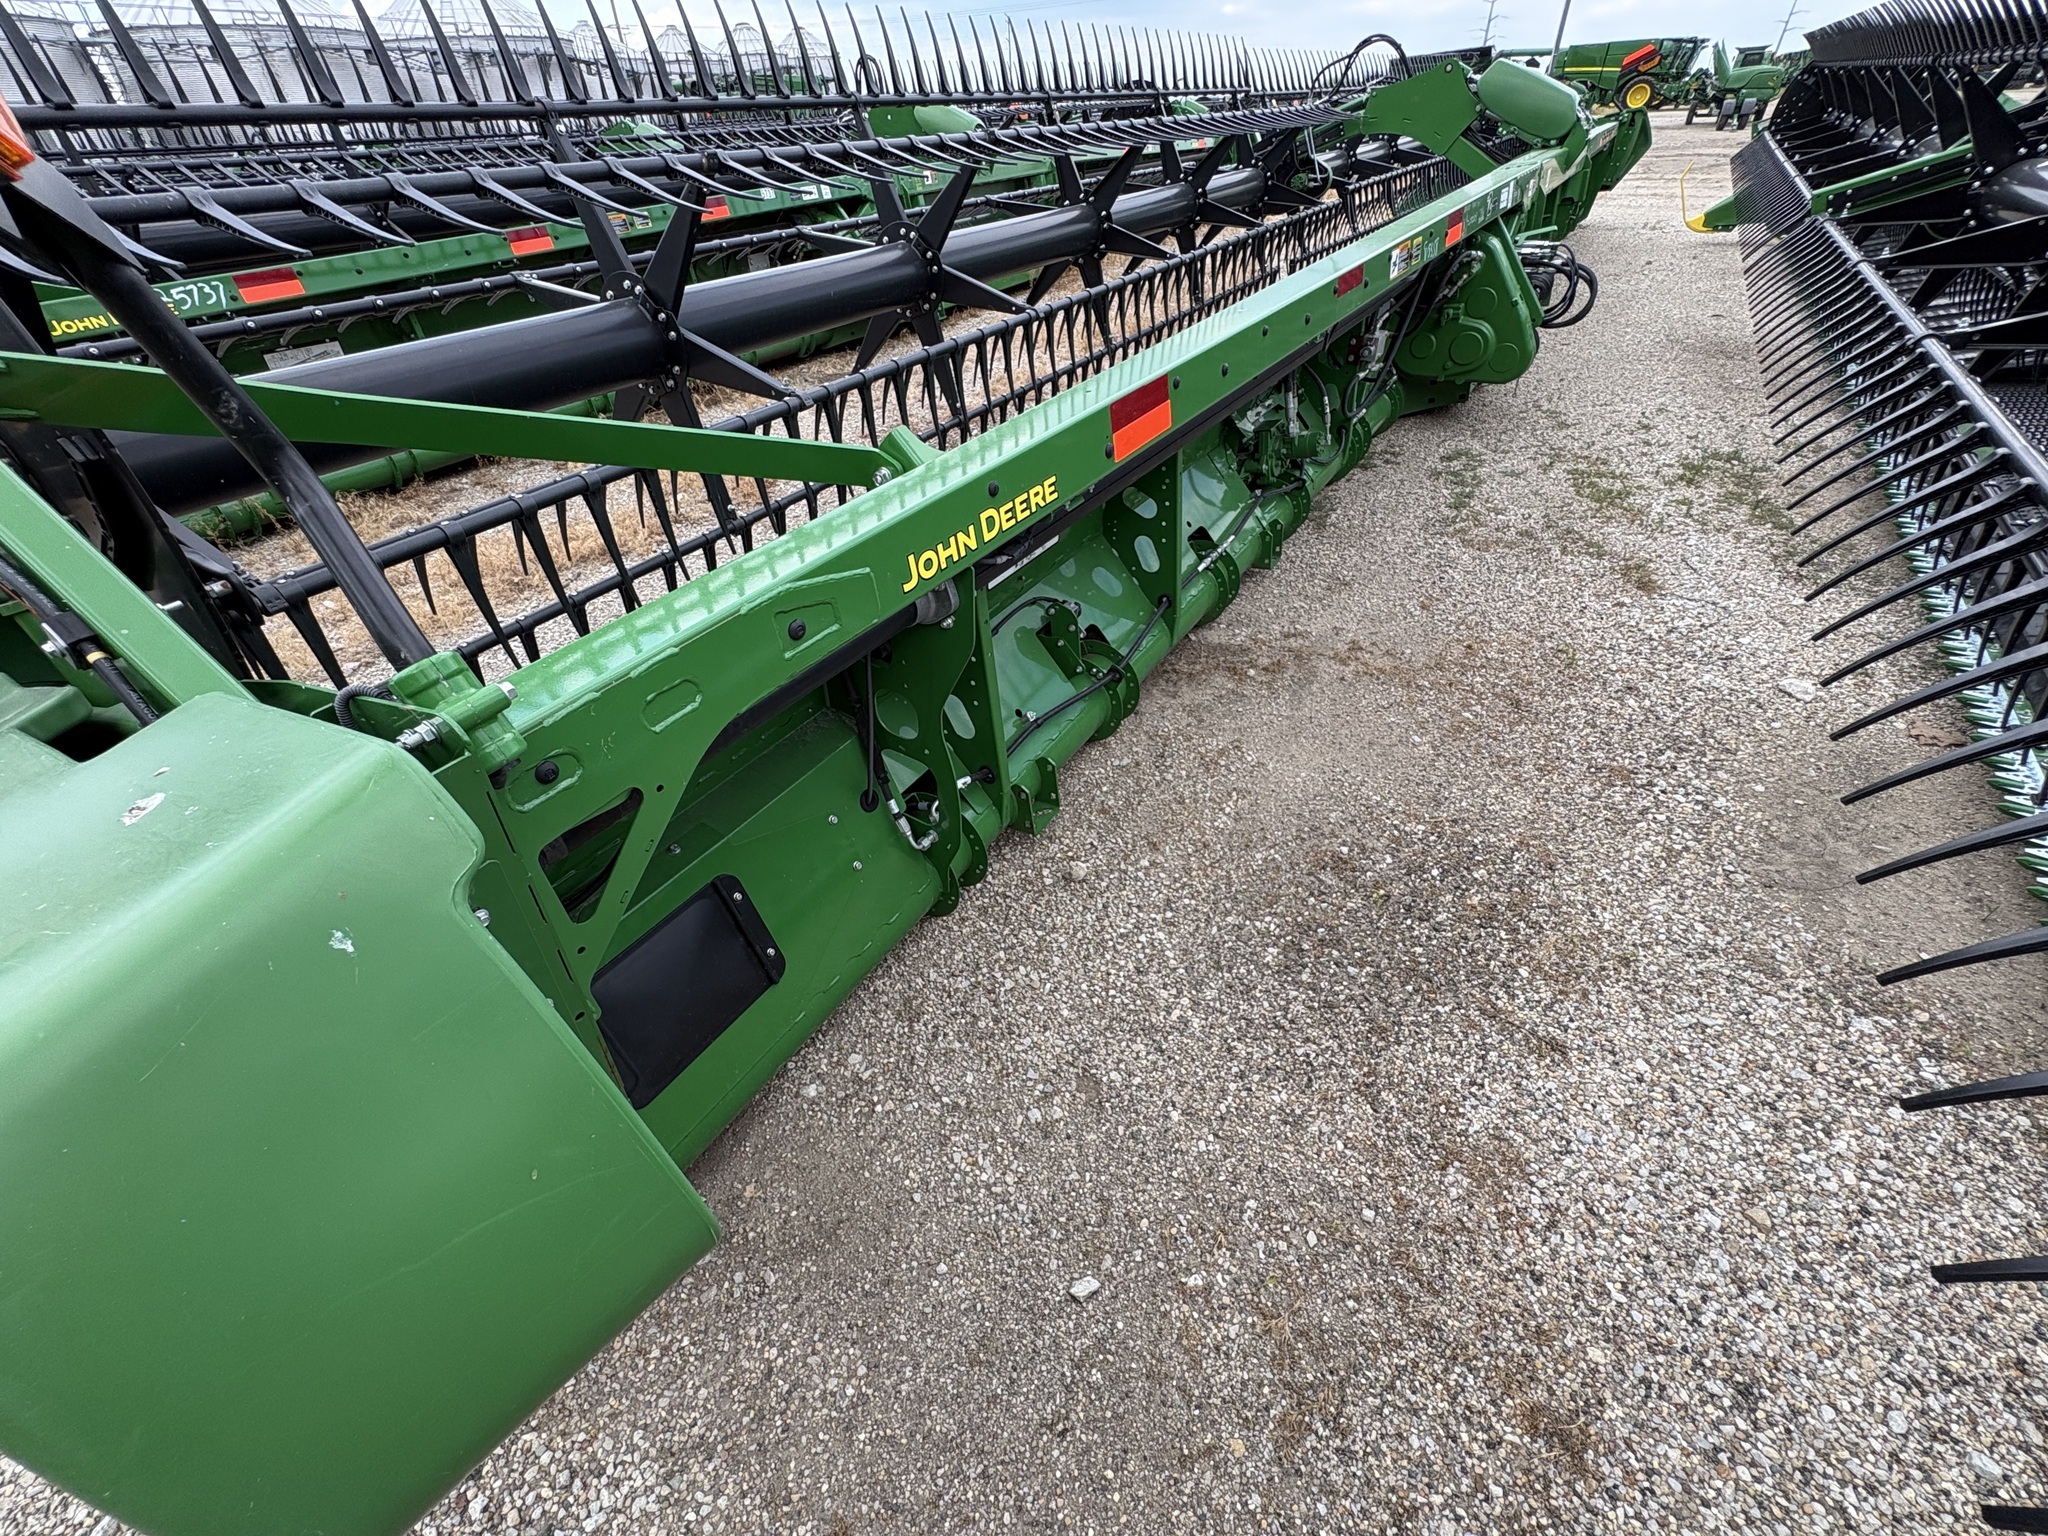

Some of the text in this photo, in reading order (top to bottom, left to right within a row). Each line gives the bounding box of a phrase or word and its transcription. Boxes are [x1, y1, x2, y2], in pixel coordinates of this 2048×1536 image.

[50, 314, 108, 336] JOHN
[902, 474, 1059, 594] JOHN DEERE
